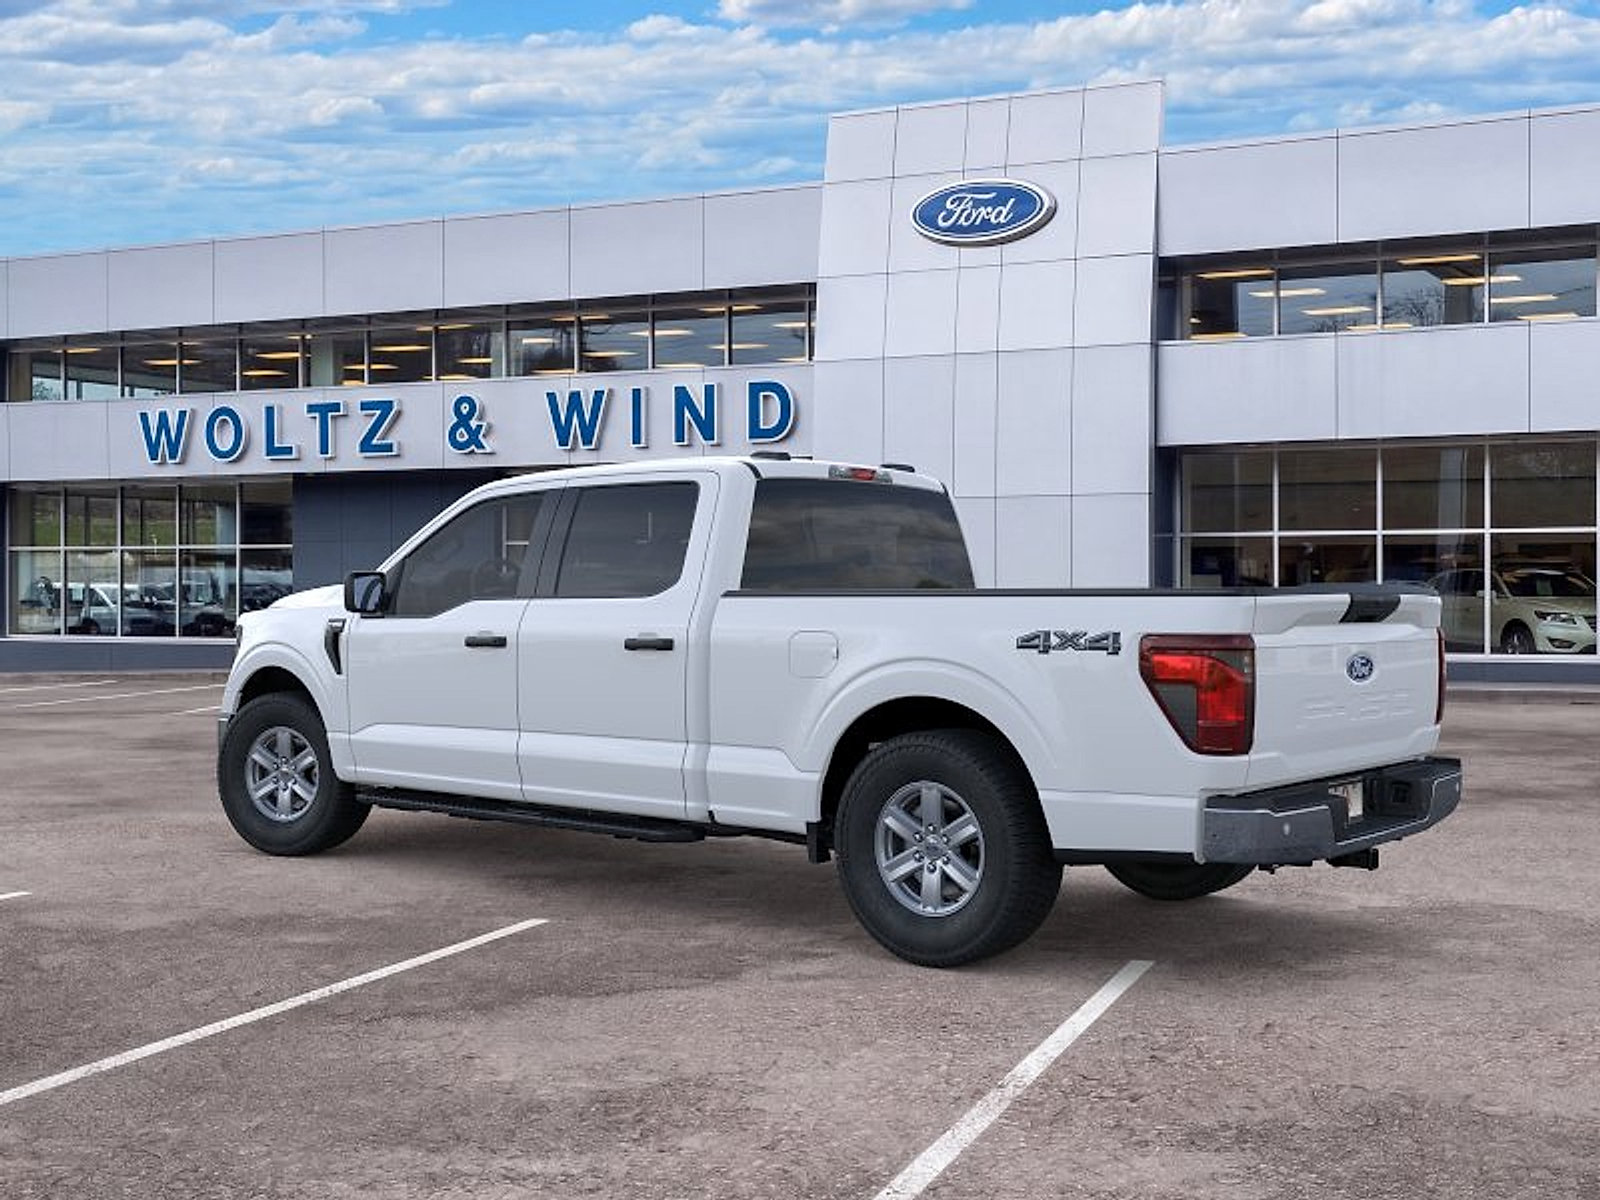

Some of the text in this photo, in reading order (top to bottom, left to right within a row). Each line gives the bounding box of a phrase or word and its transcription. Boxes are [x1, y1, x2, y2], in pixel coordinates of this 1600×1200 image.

[937, 191, 1015, 228] Ford
[139, 379, 796, 463] WOLTZ & WIND
